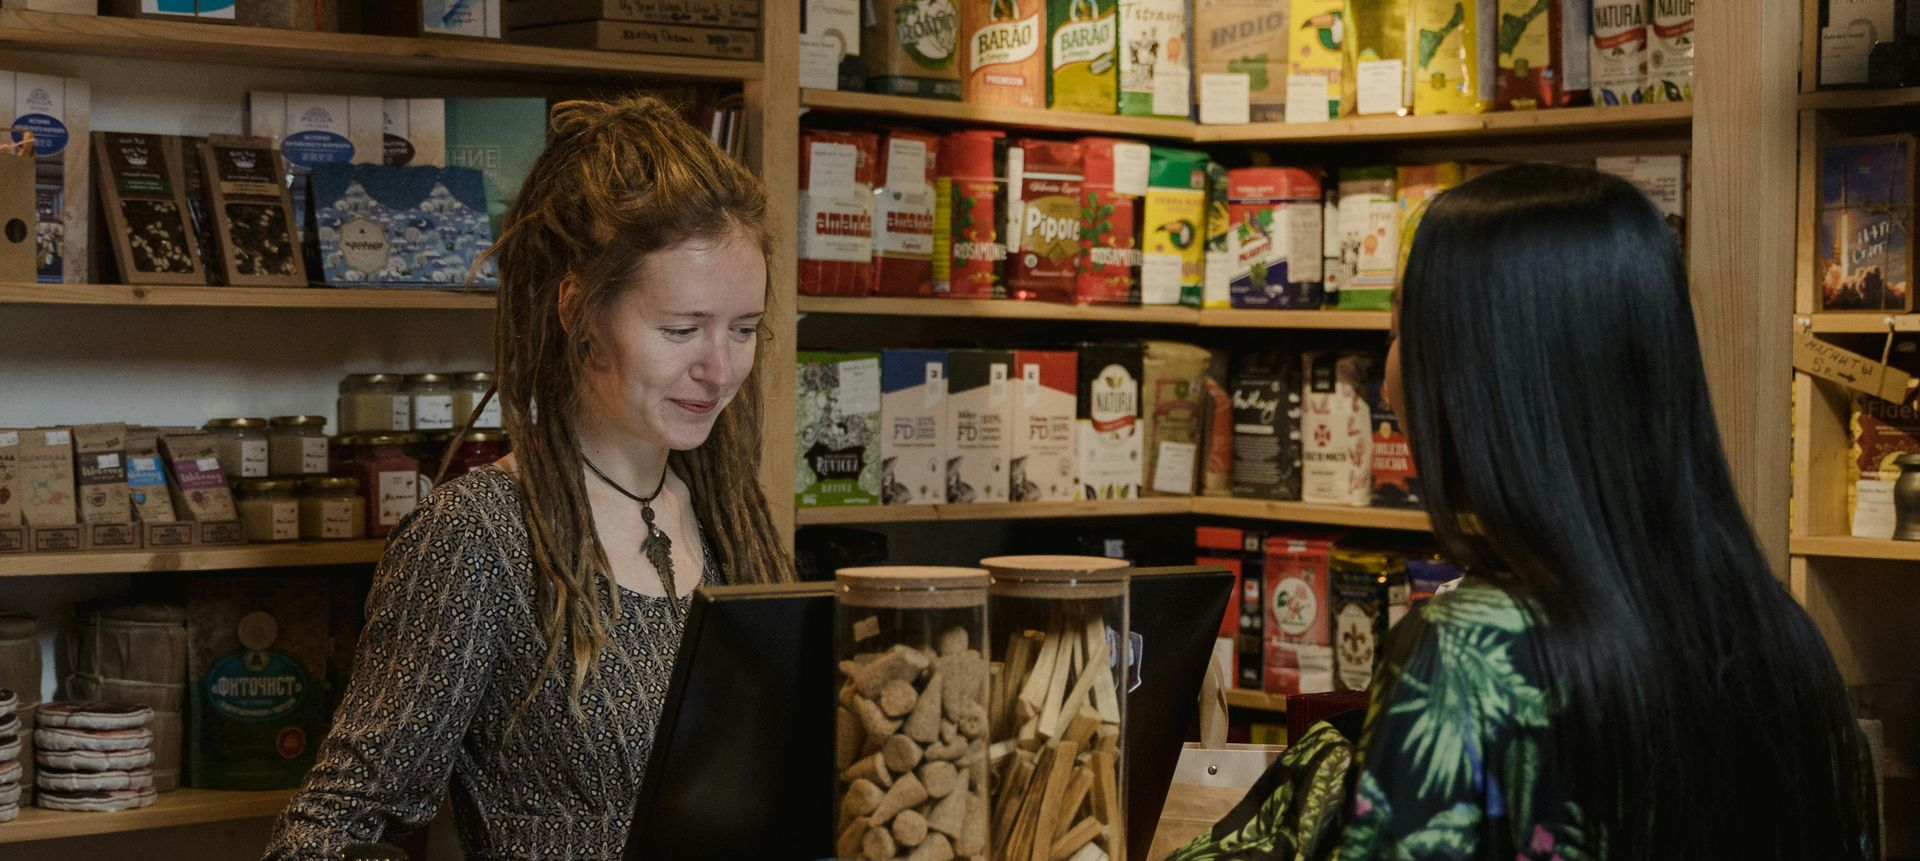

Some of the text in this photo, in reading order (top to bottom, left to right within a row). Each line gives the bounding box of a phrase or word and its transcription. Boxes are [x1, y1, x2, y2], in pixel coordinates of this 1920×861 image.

[1211, 11, 1283, 49] INDIO
[1595, 4, 1641, 29] NATURA
[978, 24, 1032, 55] BARÃO
[1061, 23, 1110, 51] BARÃO
[816, 209, 872, 238] amanda
[887, 208, 933, 235] amanda
[1804, 340, 1874, 376] МАГНИТЫ
[1096, 391, 1134, 414] NATURA
